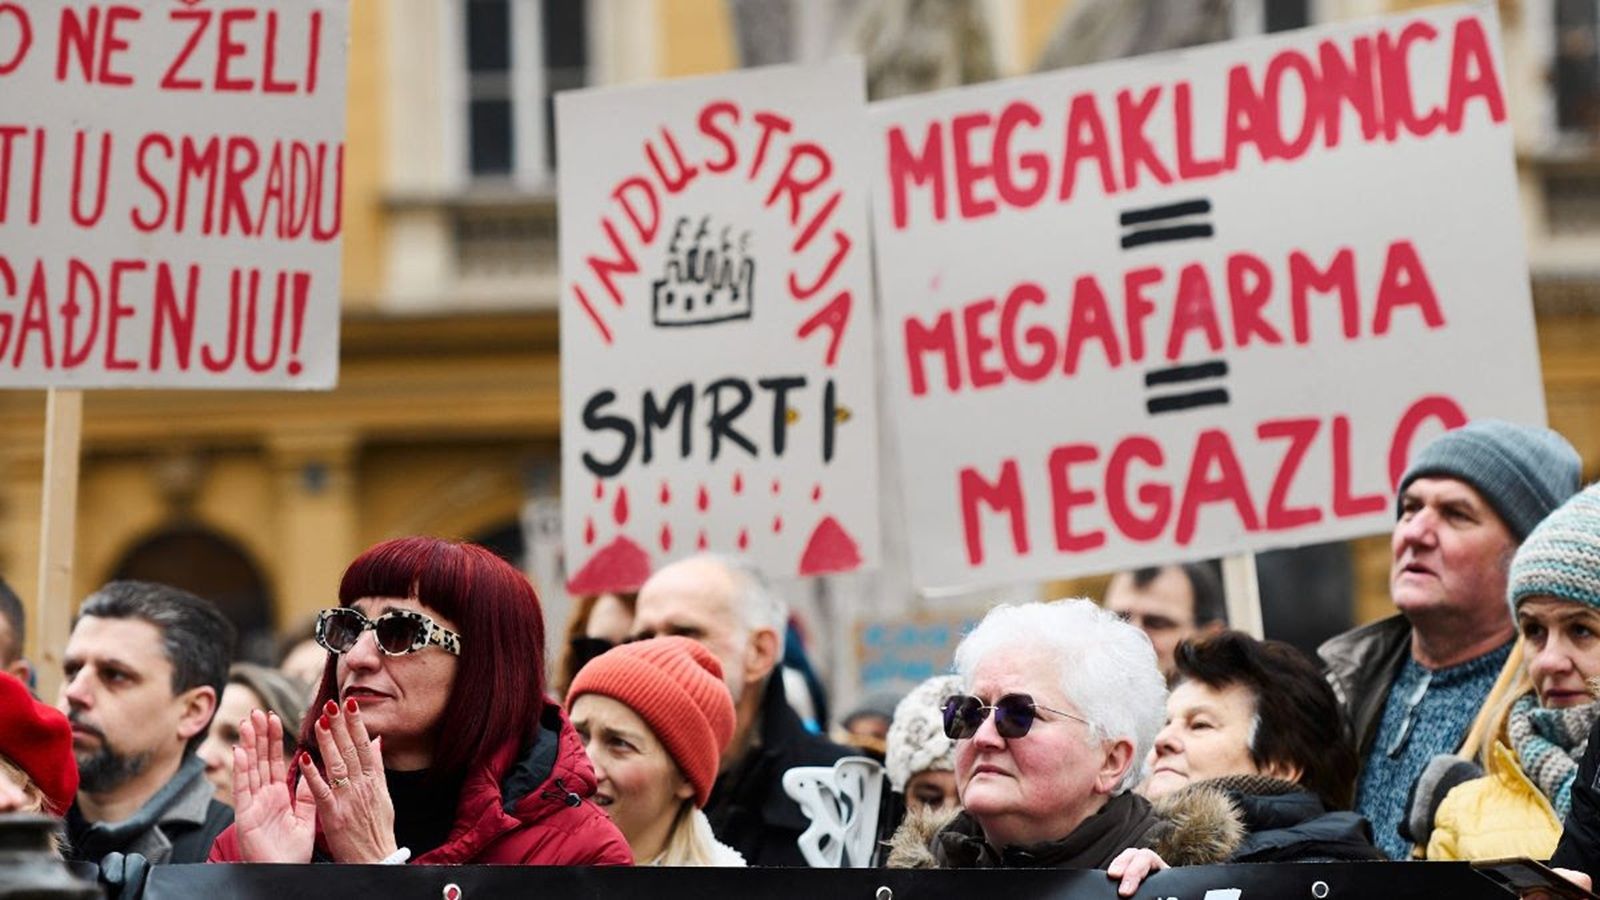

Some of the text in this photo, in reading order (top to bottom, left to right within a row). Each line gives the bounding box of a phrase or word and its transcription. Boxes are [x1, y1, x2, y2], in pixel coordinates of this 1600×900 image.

[55, 5, 142, 87] NE
[160, 0, 322, 94] ŽELI
[885, 16, 1508, 231] MEGAKLAONICA
[0, 125, 344, 242] TI U SMRADU
[573, 101, 853, 367] INDUSTRIJA
[902, 240, 1447, 398] MEGAFARMA
